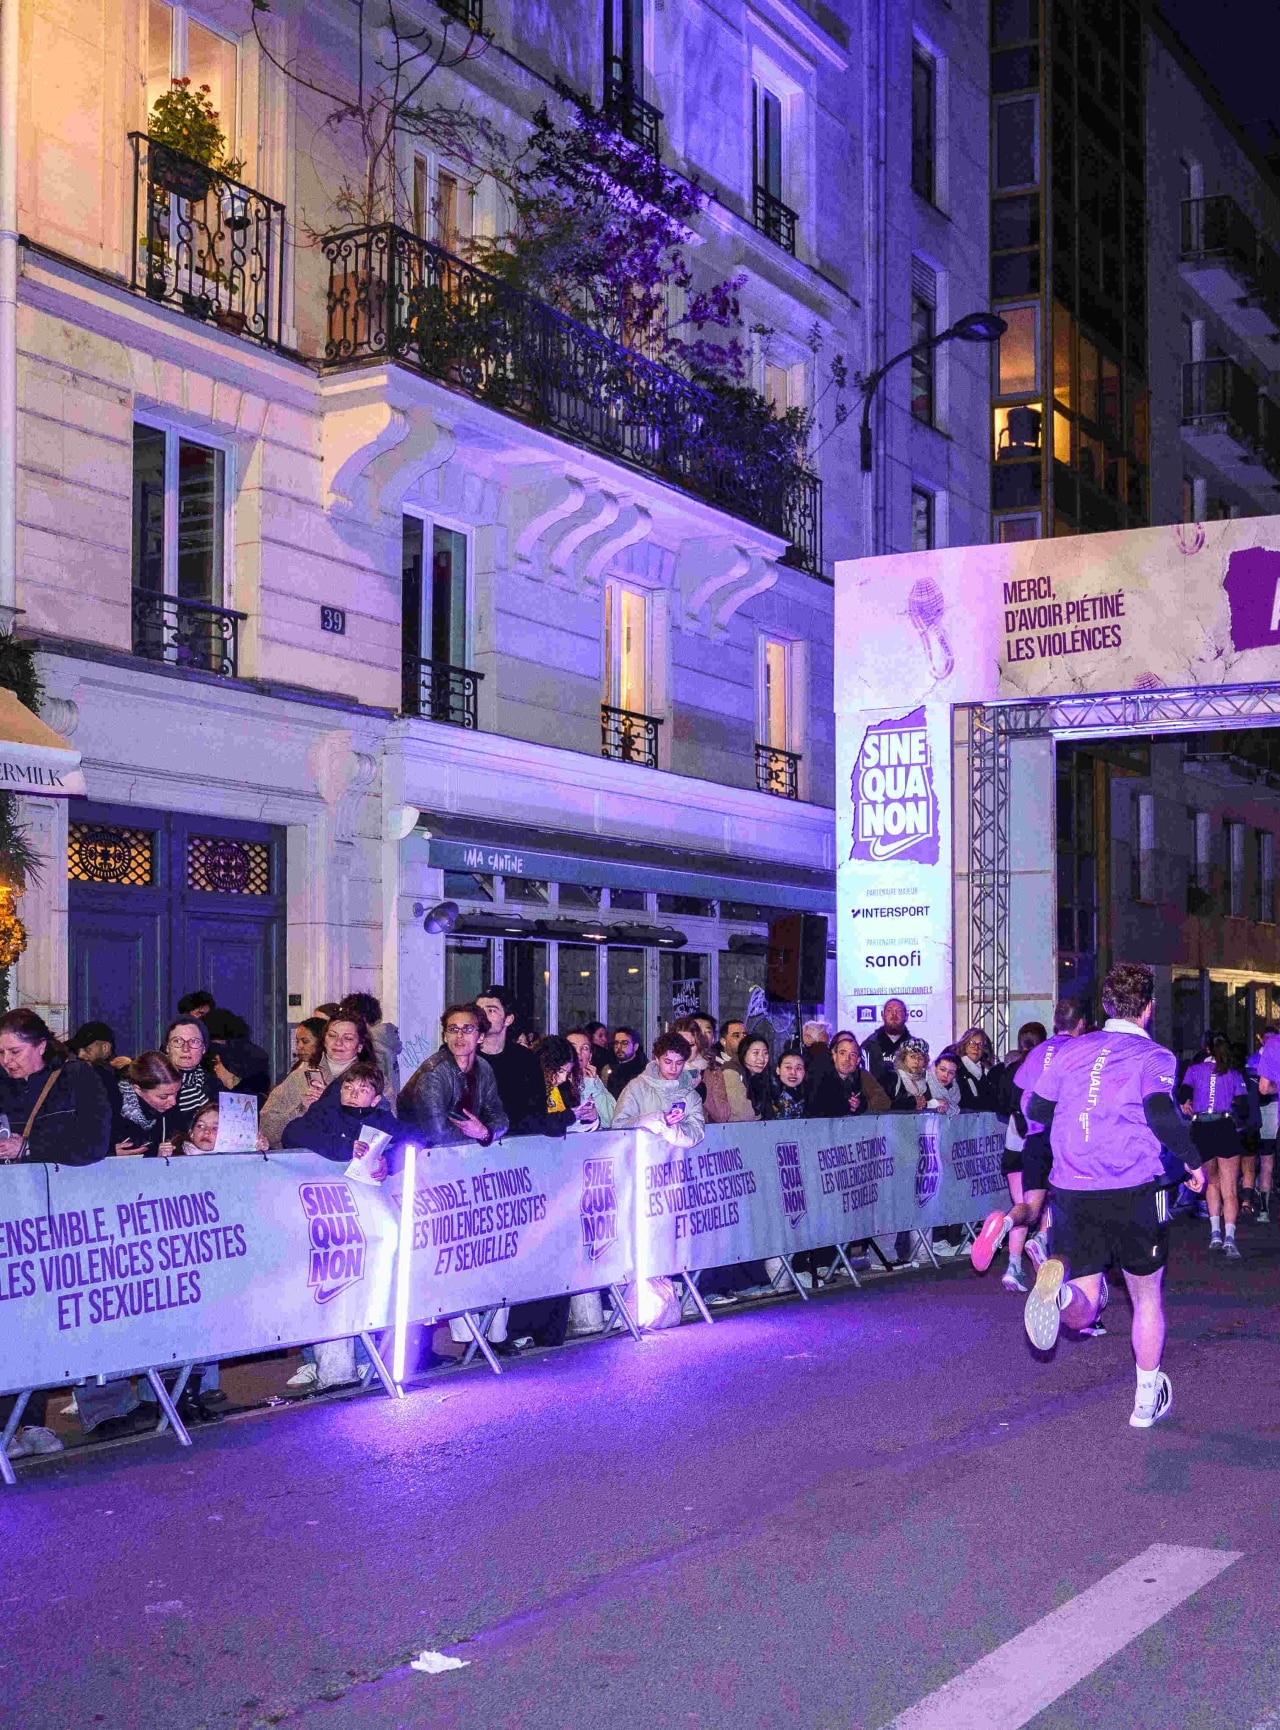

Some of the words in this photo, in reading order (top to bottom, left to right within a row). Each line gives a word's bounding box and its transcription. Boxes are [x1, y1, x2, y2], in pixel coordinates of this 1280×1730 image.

[1003, 576, 1056, 605] MERCI,
[324, 609, 342, 632] 39
[1005, 603, 1063, 633] D'AVOIR
[1066, 588, 1126, 624] PIÉTINÉ
[1006, 636, 1035, 662] LES
[1037, 624, 1122, 658] VIOLENCES
[864, 731, 926, 768] SINE
[863, 765, 927, 804] QUA
[863, 801, 927, 837] NON
[862, 906, 930, 918] INTERSPORT
[865, 950, 921, 968] sanofi
[1209, 1076, 1217, 1108] EQUALITY
[777, 1145, 799, 1167] SINE
[986, 1130, 1006, 1153] PIÉTIN
[585, 1161, 612, 1188] SINE
[645, 1157, 698, 1190] ENSEMBLE,
[698, 1147, 744, 1178] PIÉTINONS
[781, 1166, 802, 1191] QUA
[821, 1172, 835, 1195] LES
[980, 1174, 1009, 1195] SEXUELLE
[303, 1186, 356, 1216] SINE
[392, 1179, 472, 1218] SEMBLE,
[472, 1166, 533, 1204] PIÉTINONS
[582, 1187, 616, 1216] QUA
[664, 1180, 718, 1213] VIOLENCES
[718, 1170, 756, 1201] SEXISTES
[783, 1190, 806, 1213] NON
[842, 1192, 850, 1213] ET
[116, 1190, 220, 1239] PIÉTINONS
[413, 1220, 430, 1250] ES
[432, 1205, 494, 1246] VIOLENCES
[496, 1193, 547, 1231] SEXISTES
[583, 1214, 616, 1242] NON
[675, 1214, 688, 1240] ET
[689, 1201, 739, 1236] SEXUELLES
[312, 1215, 363, 1250] QUA
[40, 1240, 154, 1293] VIOLENCES
[157, 1224, 247, 1271] SEXISTES
[311, 1247, 363, 1283] NON
[434, 1247, 453, 1276] ET
[454, 1230, 519, 1273] SEXUELLES
[58, 1291, 84, 1331] ET
[88, 1270, 202, 1325] SEXUELLES
